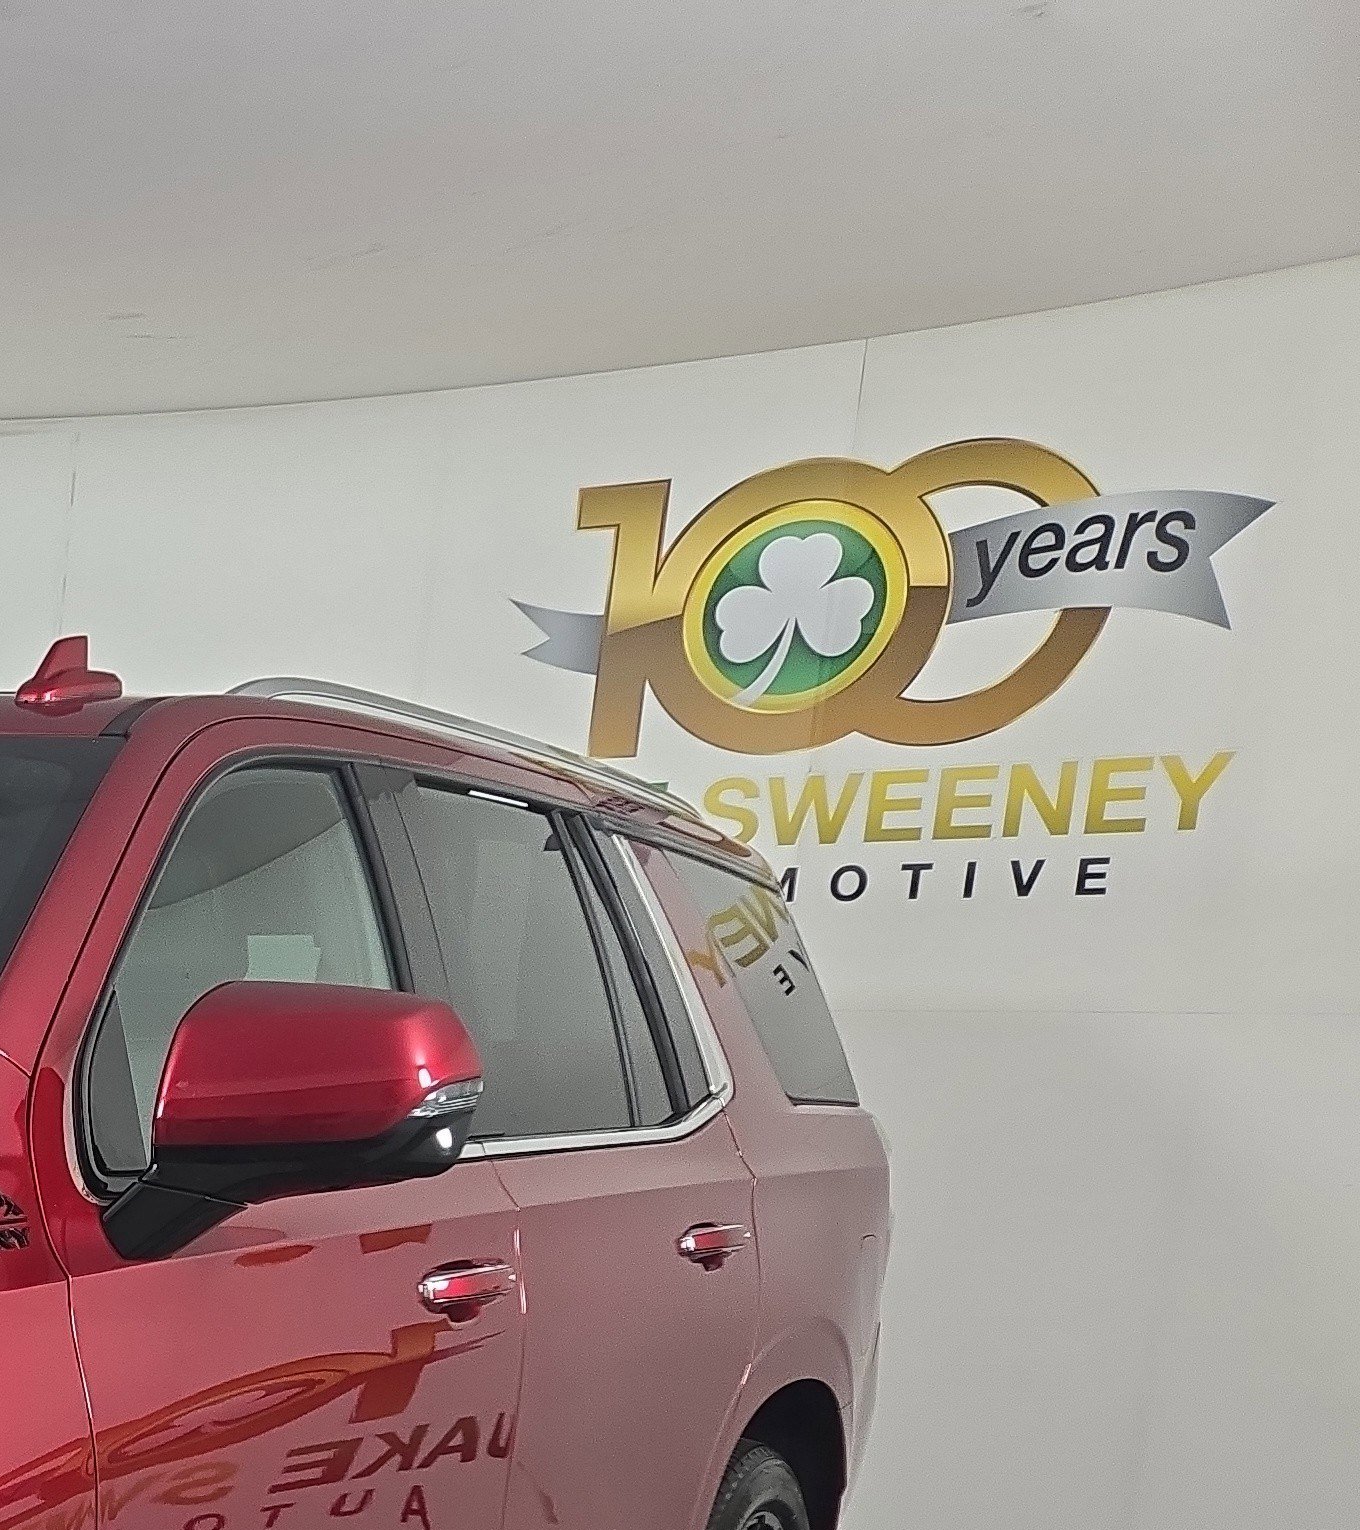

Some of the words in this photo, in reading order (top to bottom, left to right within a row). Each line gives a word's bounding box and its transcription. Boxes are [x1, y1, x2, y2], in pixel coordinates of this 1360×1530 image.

[576, 437, 1112, 758] 100
[965, 508, 1196, 608] years
[703, 751, 1236, 846] SWEENEY
[779, 856, 1111, 903] MOTIVE
